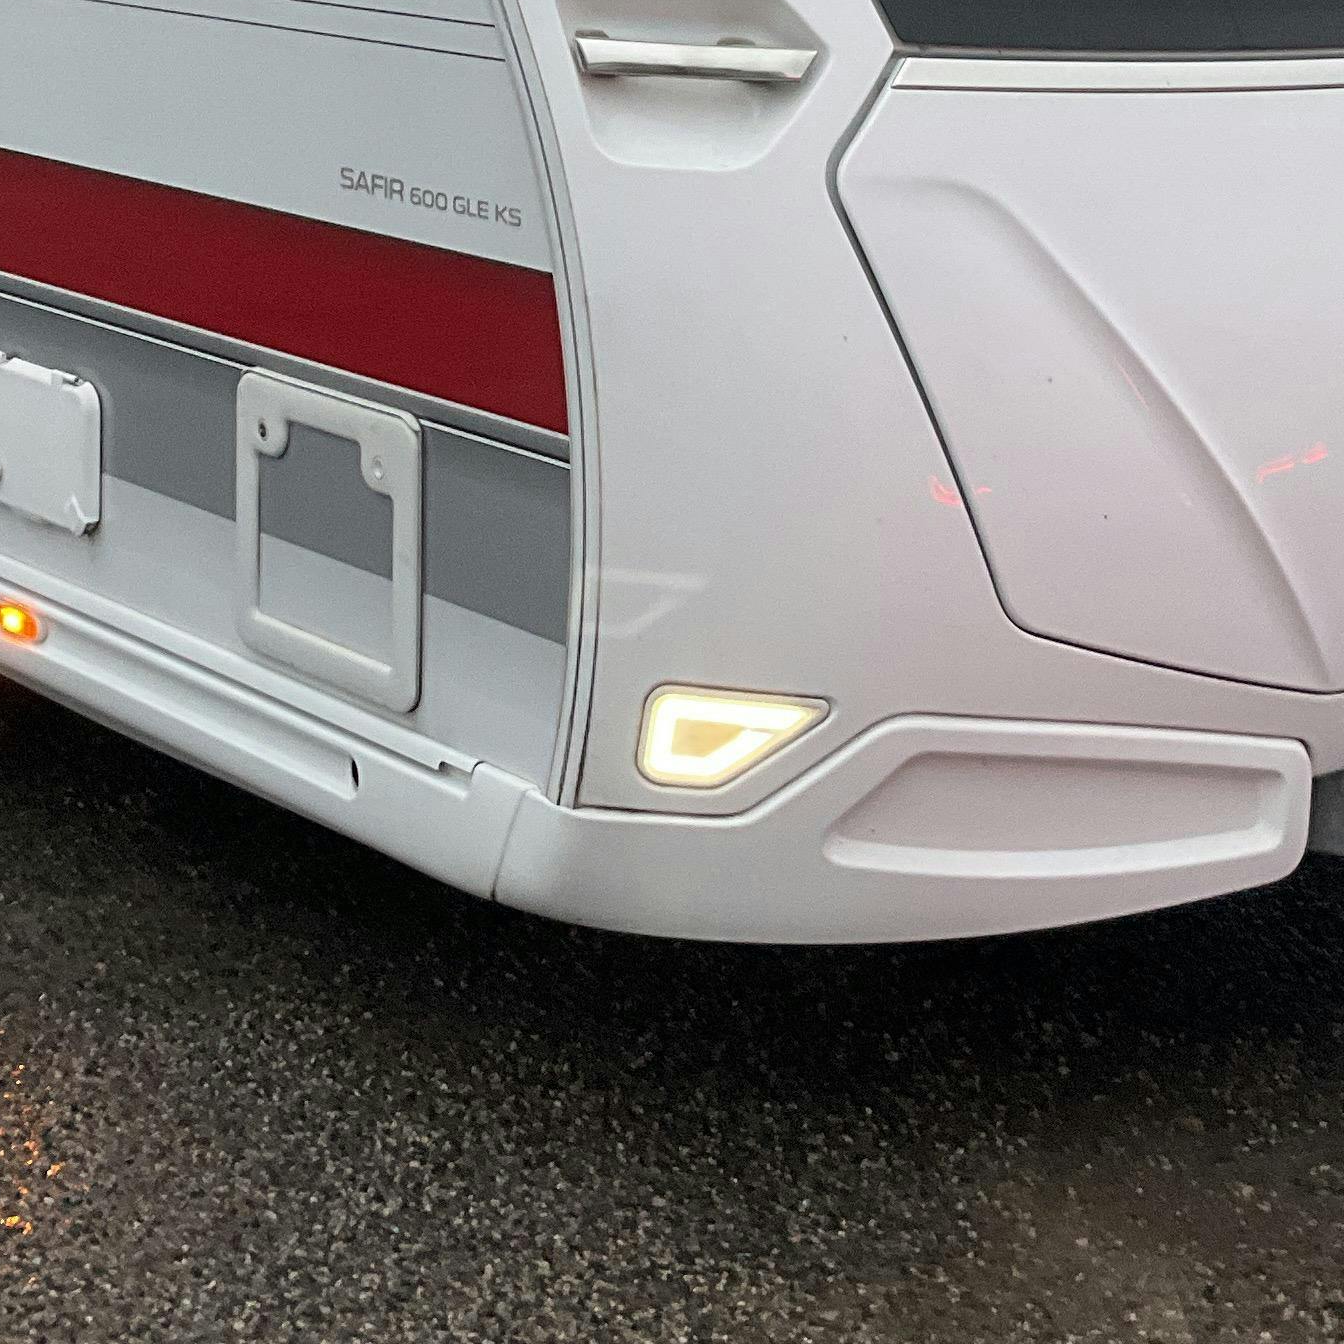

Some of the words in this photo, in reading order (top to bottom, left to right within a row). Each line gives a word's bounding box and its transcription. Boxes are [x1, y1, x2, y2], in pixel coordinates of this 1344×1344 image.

[339, 167, 404, 202] SAFIR
[410, 187, 447, 212] 600
[453, 196, 490, 220] GLE
[495, 206, 522, 228] KS
